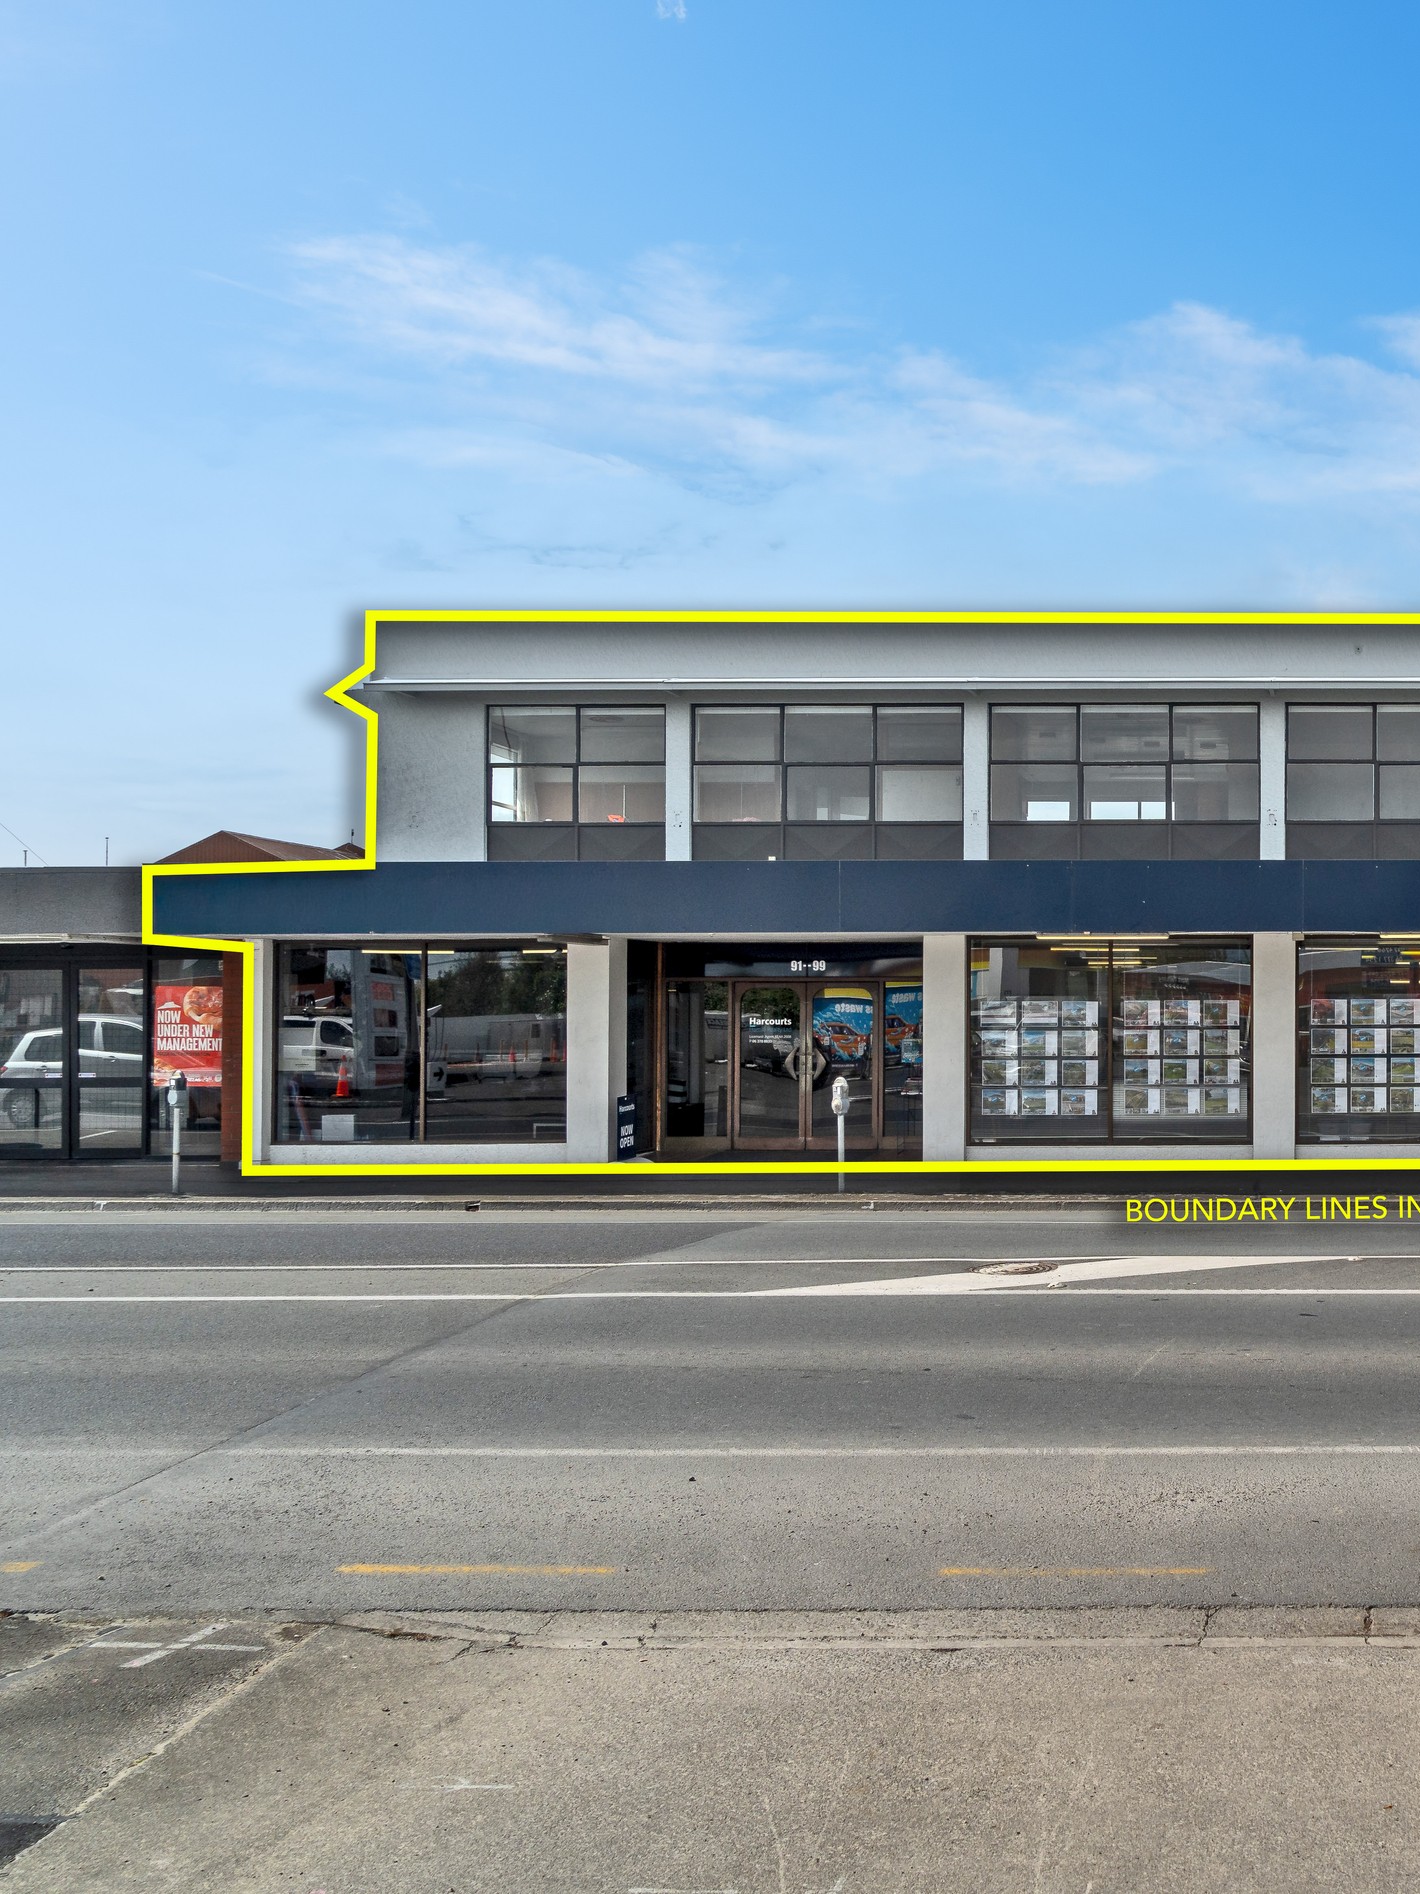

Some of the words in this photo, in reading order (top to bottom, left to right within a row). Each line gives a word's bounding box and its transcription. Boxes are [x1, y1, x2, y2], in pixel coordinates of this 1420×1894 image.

[157, 1010, 181, 1024] NOW
[749, 1017, 792, 1026] Harcourts
[158, 1024, 190, 1037] UNDER
[192, 1024, 214, 1037] NEW
[157, 1037, 223, 1051] MANAGEMENT
[621, 1124, 633, 1136] NOW
[620, 1136, 634, 1148] OPEN
